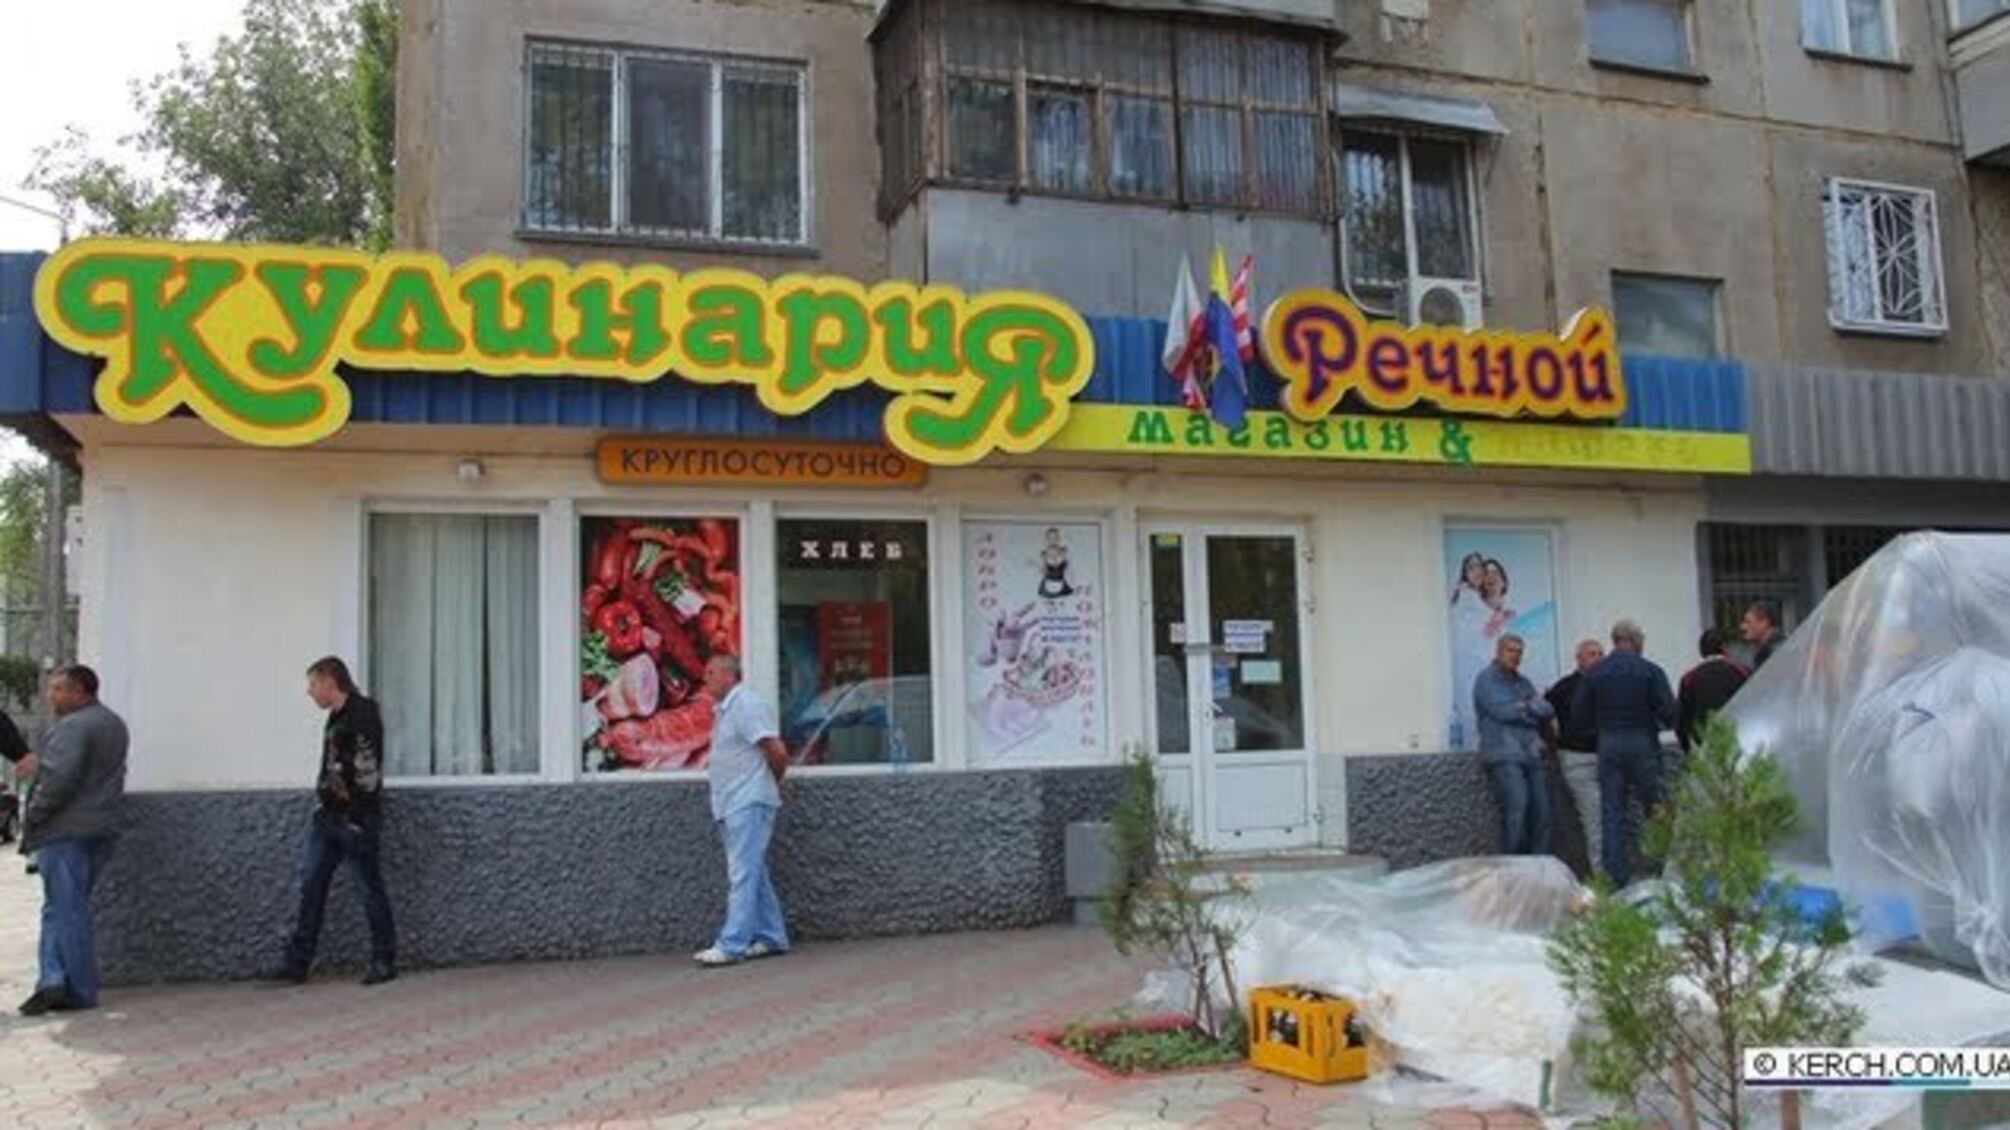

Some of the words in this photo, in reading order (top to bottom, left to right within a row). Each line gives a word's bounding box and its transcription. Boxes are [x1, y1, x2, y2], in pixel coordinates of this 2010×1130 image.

[1283, 304, 1615, 404] Речной
[620, 446, 908, 479] КРУГЛОСУТОЧНО
[800, 540, 904, 560] ХЛЕБ
